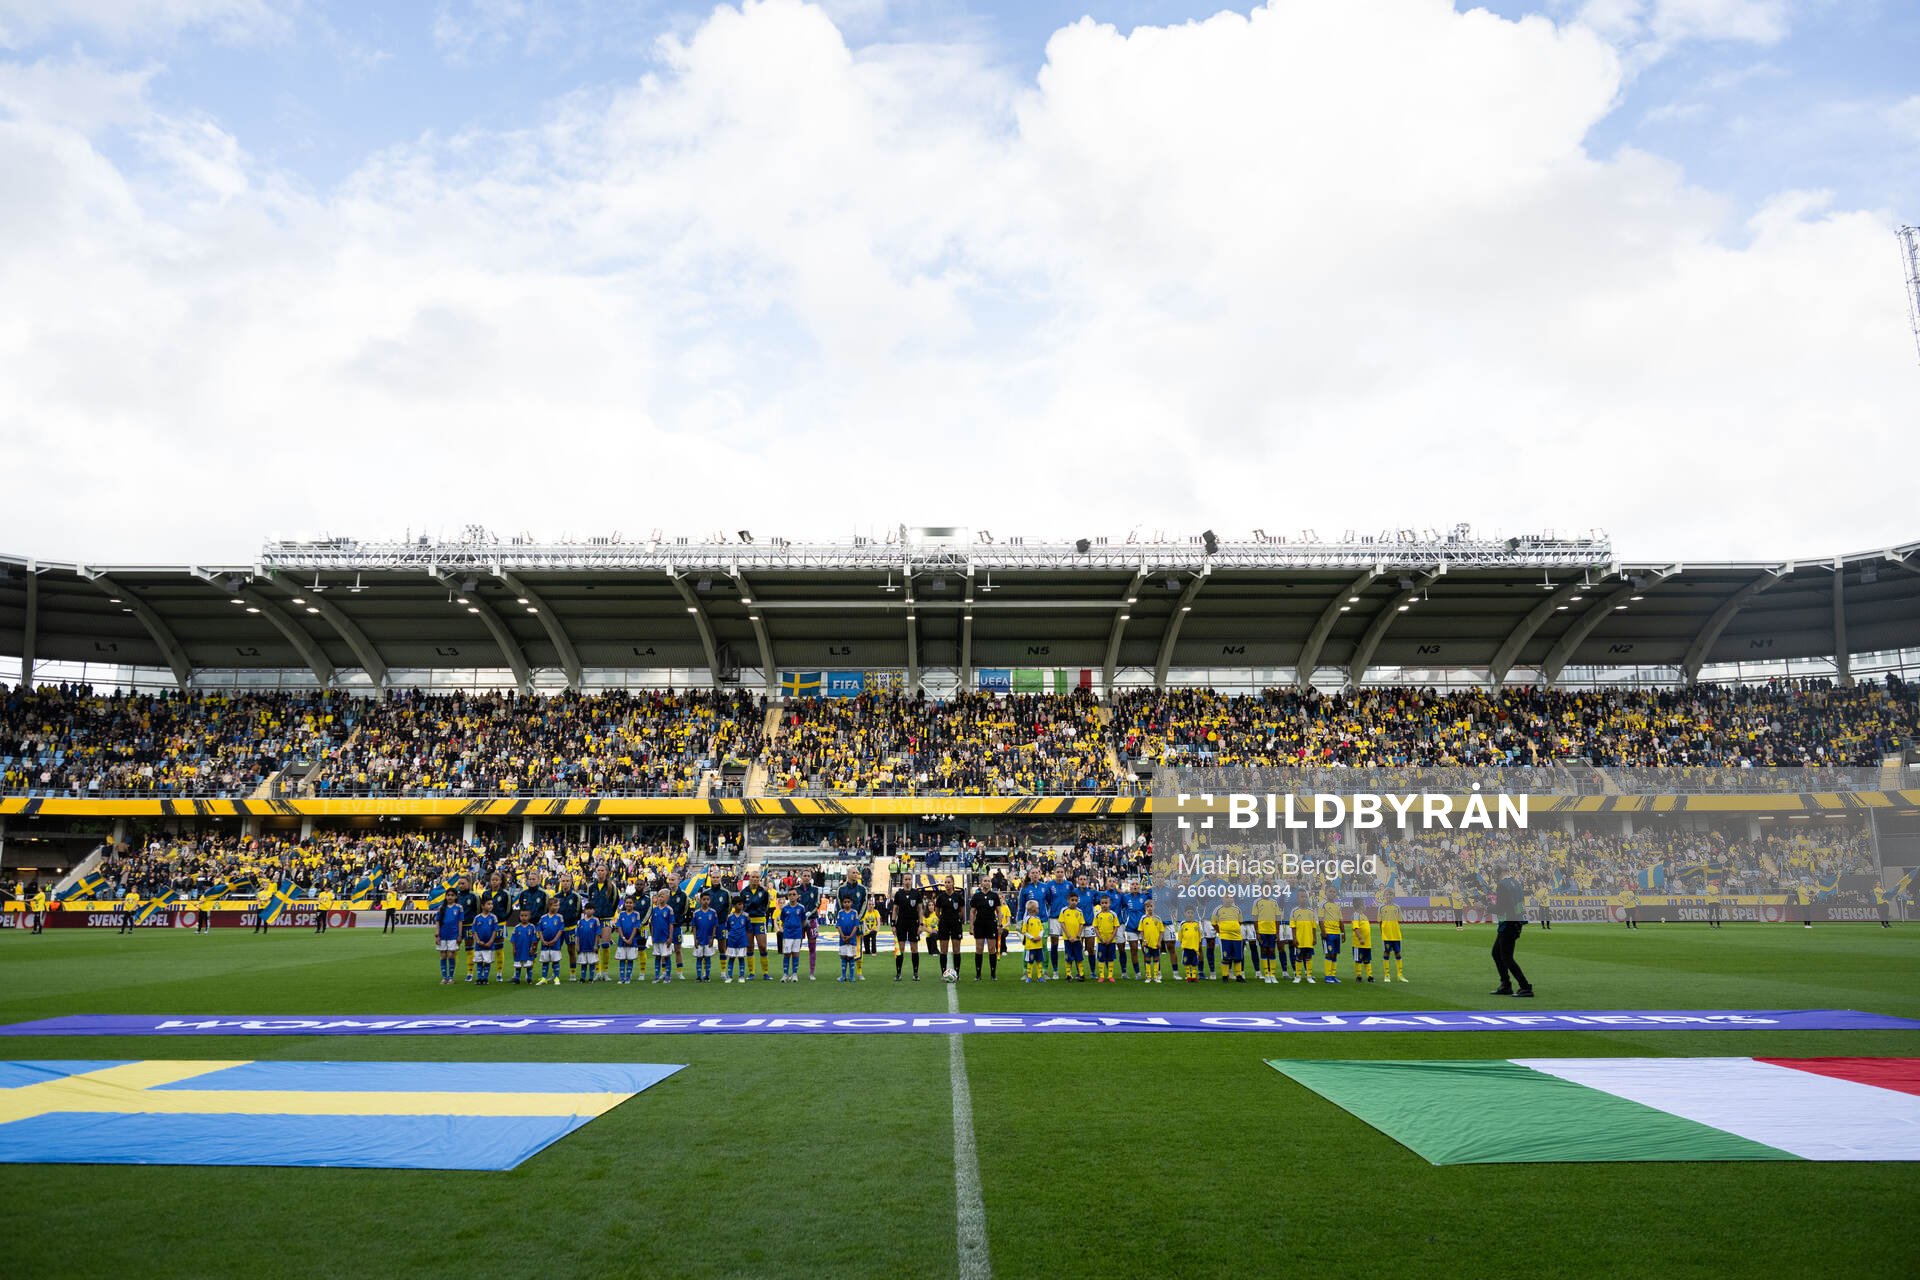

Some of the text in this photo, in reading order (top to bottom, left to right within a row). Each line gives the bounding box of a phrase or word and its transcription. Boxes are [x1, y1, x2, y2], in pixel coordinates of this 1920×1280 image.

[1608, 644, 1633, 653] N2
[1750, 639, 1774, 648] N1
[236, 648, 262, 657] L2
[435, 647, 459, 657] L3
[633, 647, 656, 656] L4
[829, 646, 851, 656] L5
[1027, 646, 1050, 655] N5
[1222, 646, 1245, 655] N4
[1416, 645, 1441, 655] N3
[832, 680, 860, 690] FIFA
[980, 676, 1009, 687] UEFA
[341, 801, 420, 812] SVERIGE
[887, 800, 966, 811] SVERIGE
[1528, 909, 1608, 921] SVNSKA SPEL
[1678, 908, 1759, 920] SVENA SPEL
[1828, 907, 1880, 920] SVENSKA
[239, 914, 319, 926] SVKA SPE
[395, 913, 437, 925] SVENSK
[155, 1015, 1780, 1030] WOMEN'S EUROPEAN QUALIFIERS
